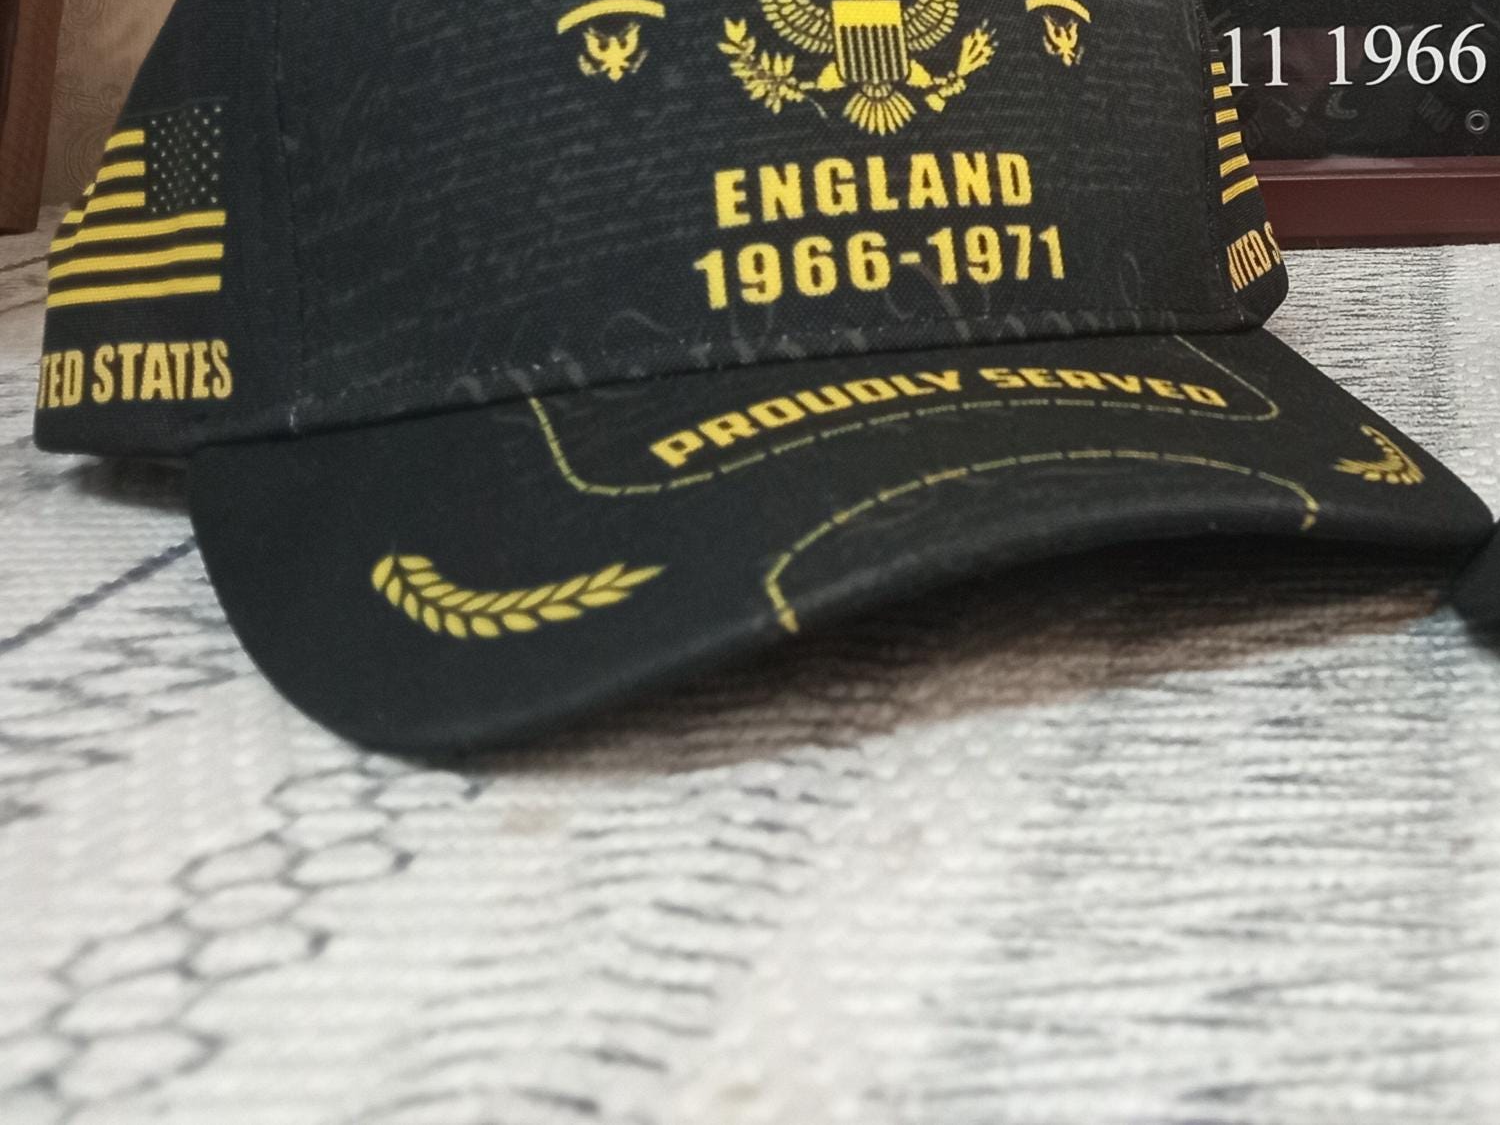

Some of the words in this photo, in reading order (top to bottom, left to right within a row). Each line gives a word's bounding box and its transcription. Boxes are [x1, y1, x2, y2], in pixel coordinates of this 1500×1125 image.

[1223, 26, 1289, 87] 11
[1327, 23, 1487, 86] 1966
[713, 151, 1034, 228] ENGLAND
[697, 225, 1066, 309] 1966-1971
[92, 339, 233, 403] STATES
[650, 368, 962, 468] PROUDLY
[978, 366, 1228, 408] SERVED
